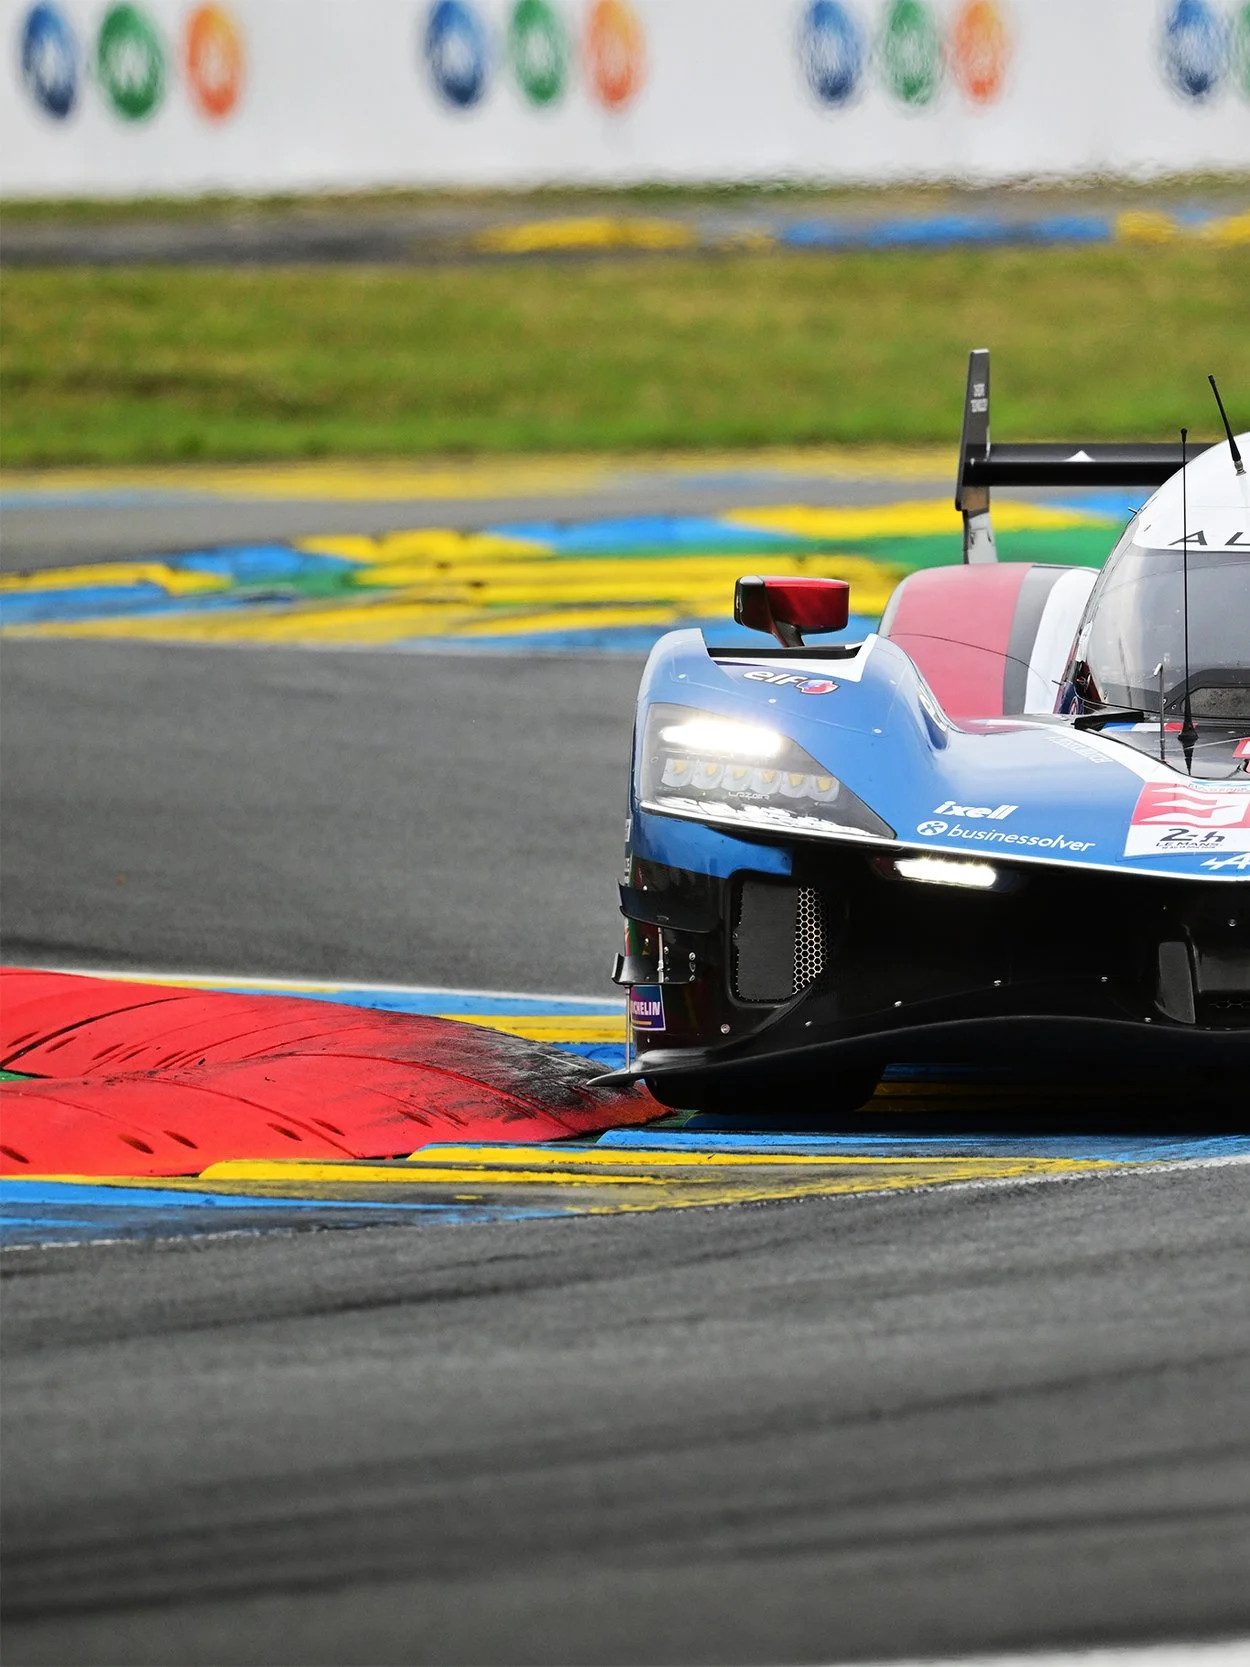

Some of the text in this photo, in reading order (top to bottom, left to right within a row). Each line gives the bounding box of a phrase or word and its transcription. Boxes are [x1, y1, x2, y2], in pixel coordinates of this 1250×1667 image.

[743, 671, 809, 686] elf
[932, 800, 1020, 820] ixell
[947, 823, 1096, 852] businessolver
